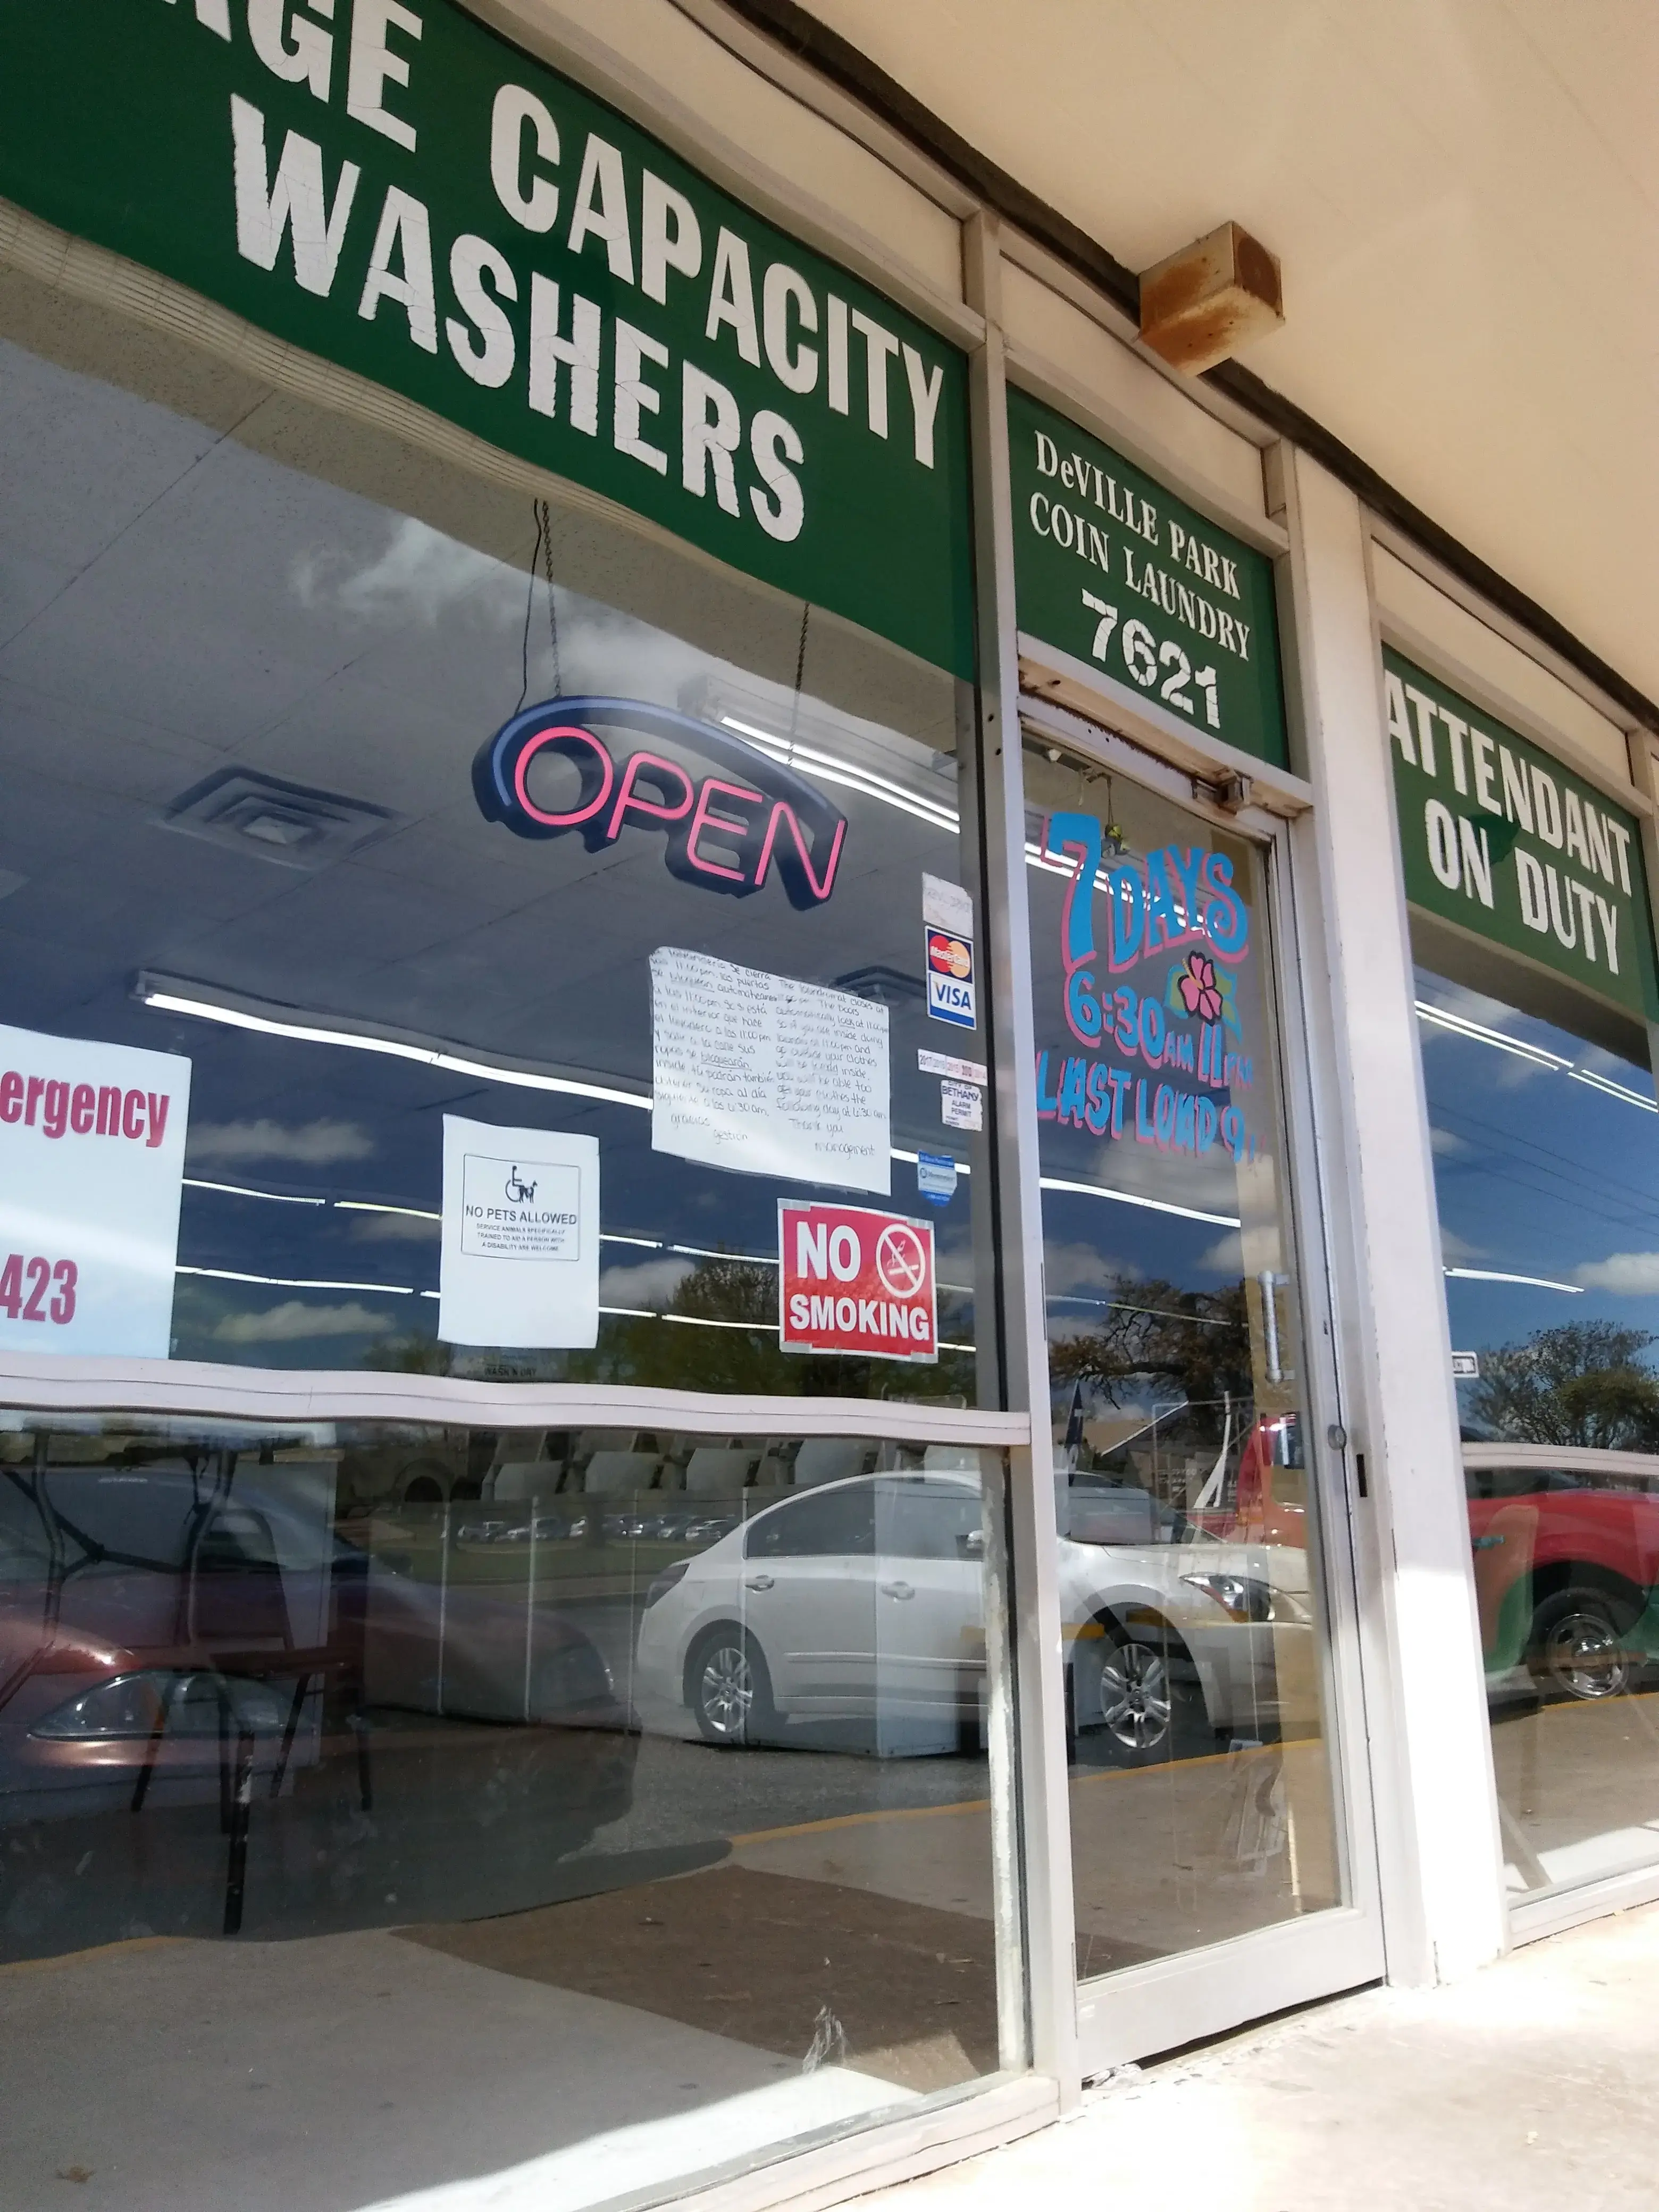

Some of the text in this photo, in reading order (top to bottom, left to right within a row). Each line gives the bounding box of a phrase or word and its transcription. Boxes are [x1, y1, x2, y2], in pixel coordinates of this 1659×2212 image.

[490, 83, 944, 470] CAPACITY
[230, 93, 805, 542] WASHERS
[1034, 429, 1241, 600] DeVILLE PARK
[1029, 492, 1250, 661] COIN LAUNDRY
[1082, 588, 1221, 730] 7621
[1384, 668, 1632, 898] ATTENDANT
[515, 726, 846, 899] OPEN
[1041, 811, 1249, 974] 7 DAYS
[1424, 798, 1620, 976] ON DUTY
[737, 978, 769, 990] puertas
[935, 982, 971, 1010] VISA
[738, 1087, 748, 1097] al
[833, 1077, 851, 1089] able
[852, 1093, 866, 1104] the
[942, 1086, 978, 1101] BETHANY
[951, 1100, 970, 1109] ALARM
[1036, 1050, 1131, 1140] LAST
[1135, 1078, 1217, 1158] LOAD
[827, 1124, 844, 1137] you
[951, 1107, 971, 1117] PERMIT
[815, 1142, 875, 1160] management
[466, 1205, 577, 1225] NO PETS ALLOWED
[476, 1223, 500, 1231] SERVICE
[797, 1221, 861, 1282] NO
[0, 1254, 78, 1325] 423
[790, 1294, 929, 1340] SMOKING
